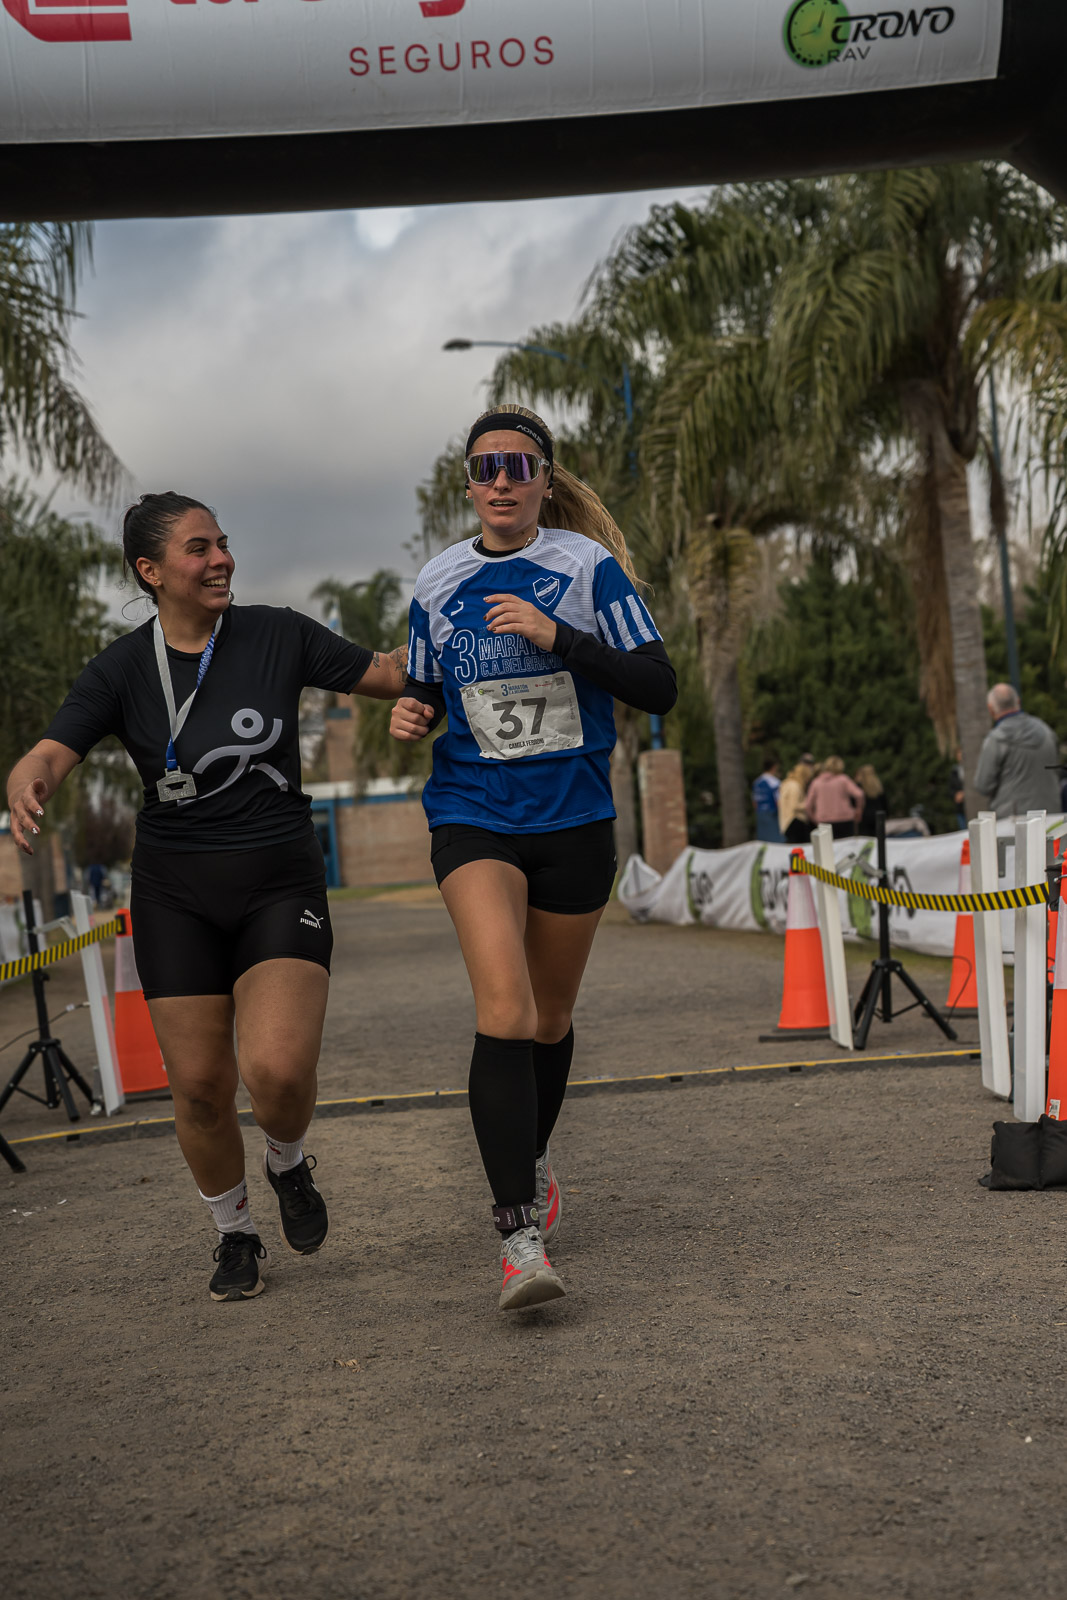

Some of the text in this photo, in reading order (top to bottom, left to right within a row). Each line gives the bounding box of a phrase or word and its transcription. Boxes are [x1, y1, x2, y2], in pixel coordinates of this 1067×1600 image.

[831, 6, 955, 44] CRONO
[349, 36, 555, 76] SEGUROS
[828, 46, 871, 63] RAV
[452, 629, 478, 685] 3
[501, 684, 509, 697] 3
[492, 697, 547, 740] 37
[300, 917, 317, 928] PUMA
